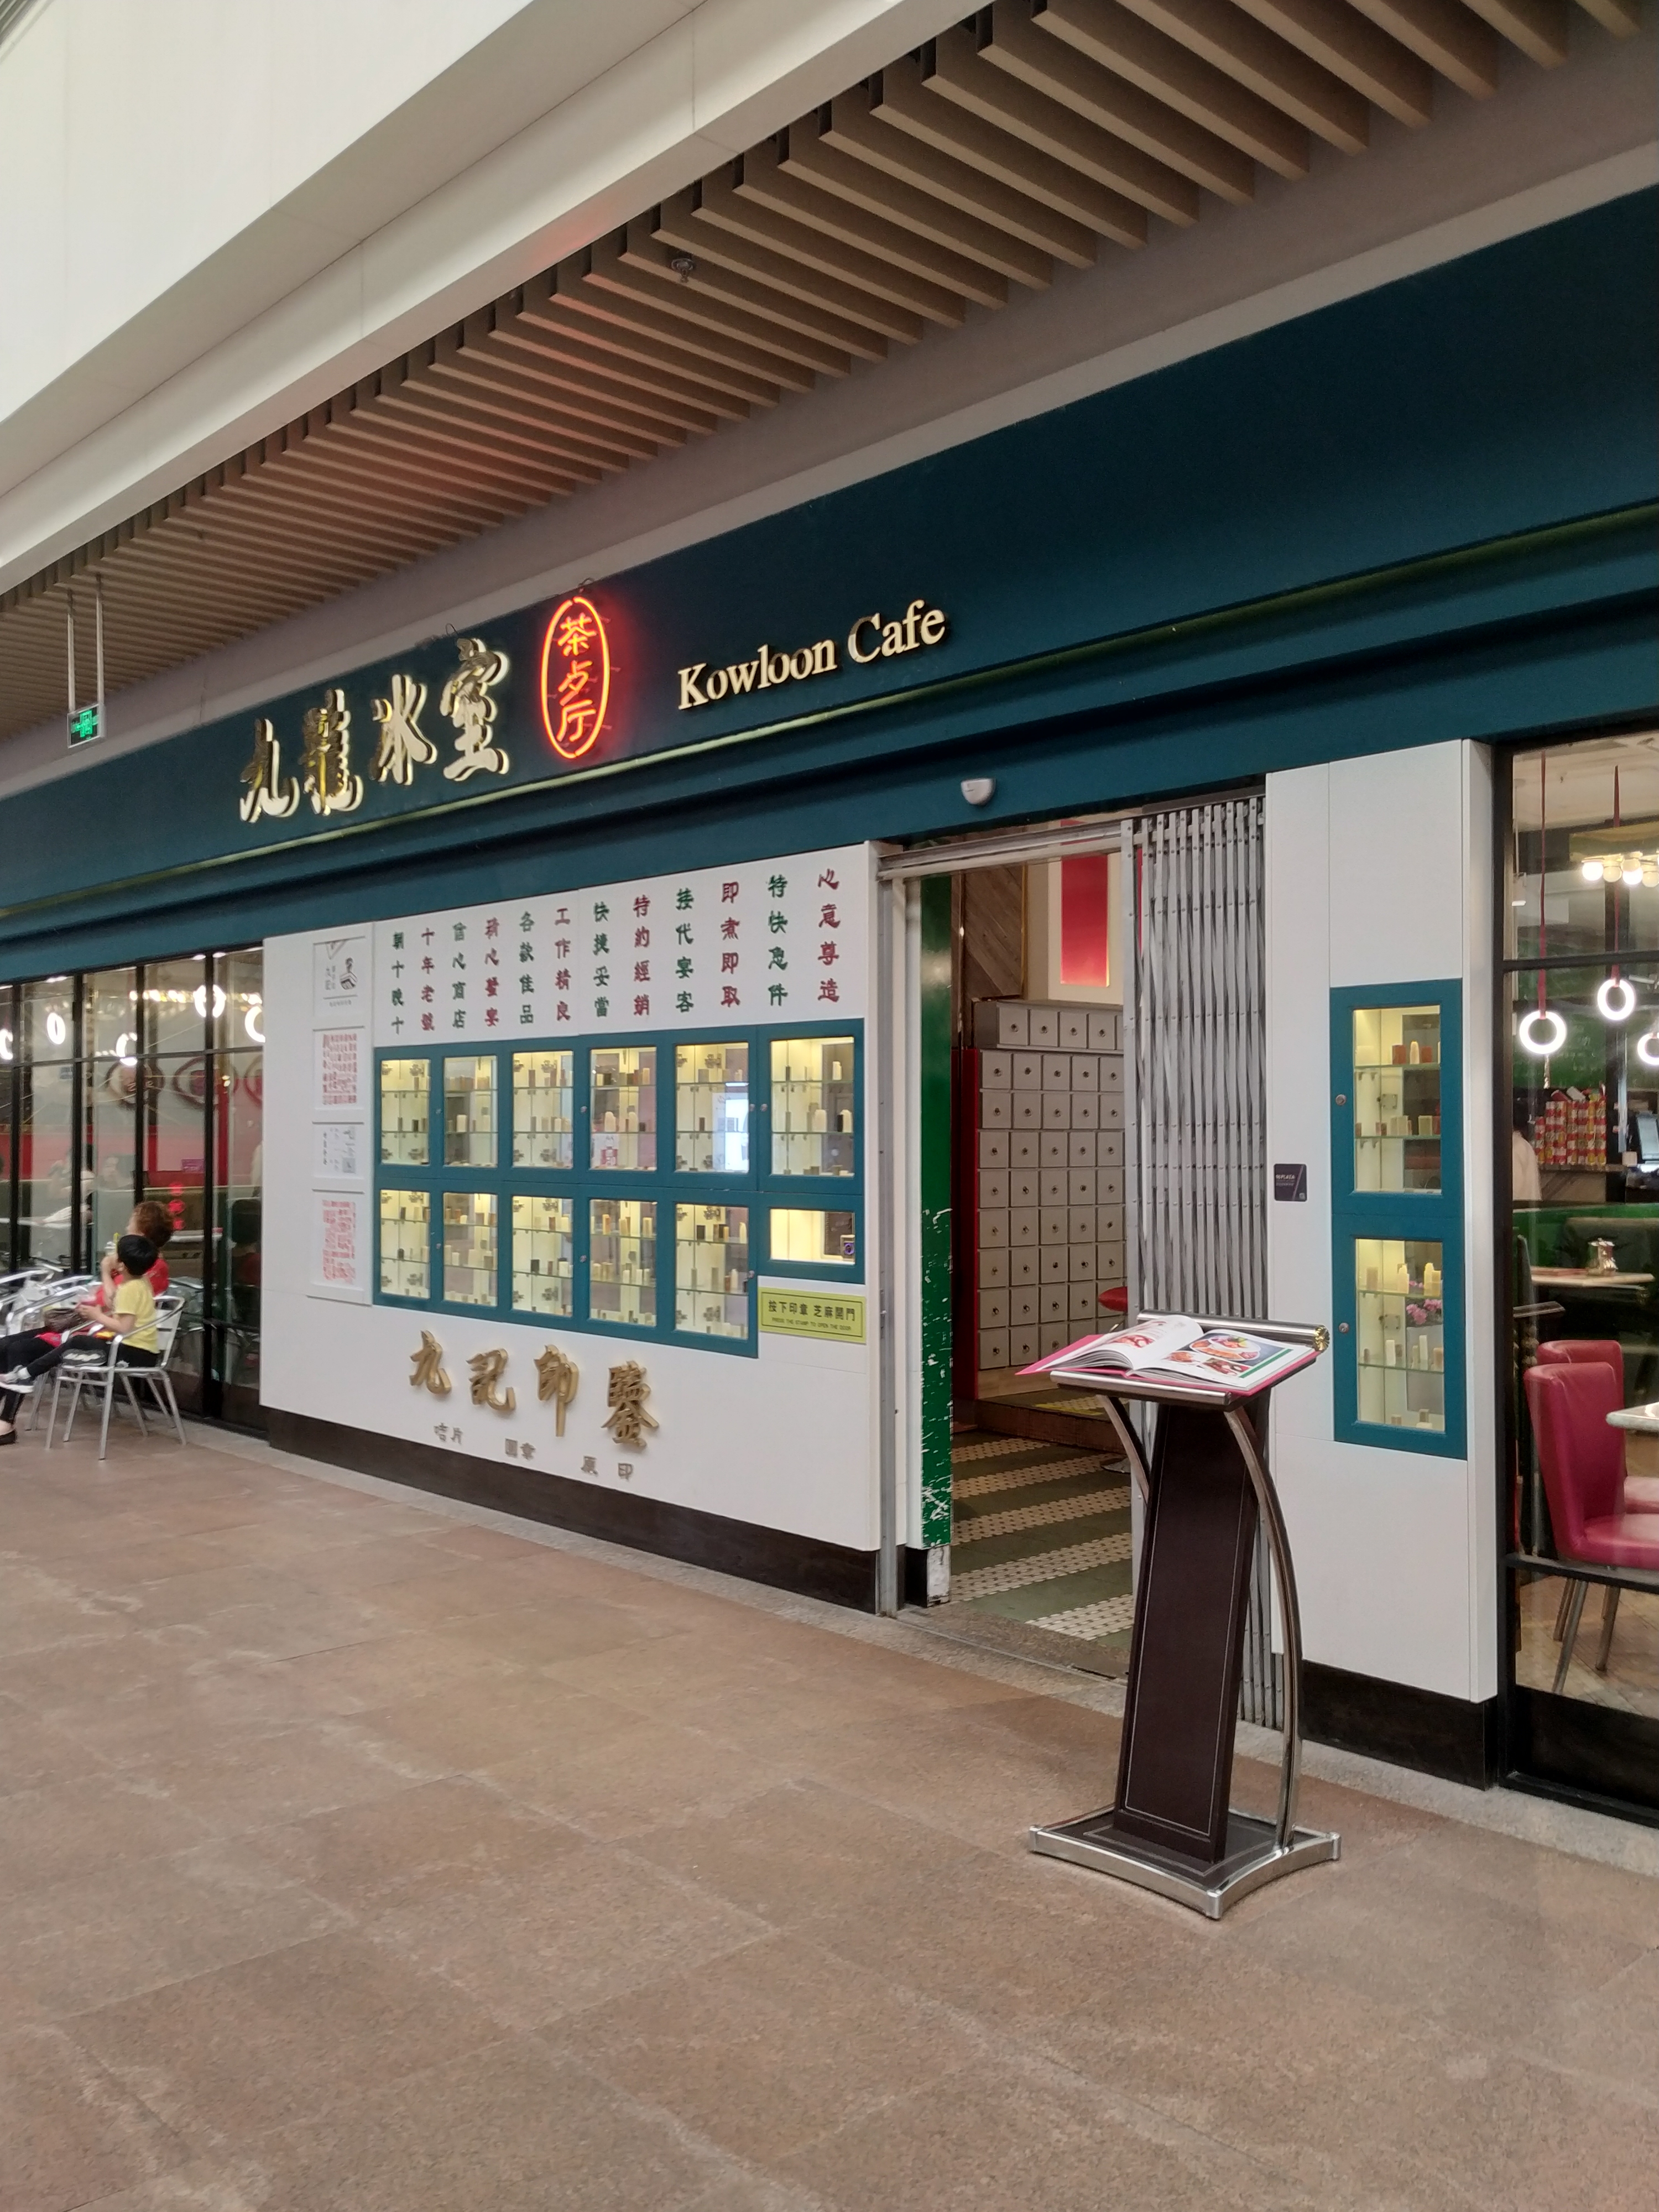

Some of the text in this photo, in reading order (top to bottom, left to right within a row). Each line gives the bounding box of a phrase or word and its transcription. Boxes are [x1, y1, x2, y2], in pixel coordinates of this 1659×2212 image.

[678, 599, 945, 710] Kowloon Cafe
[519, 911, 535, 1024] 各款佳品
[555, 908, 571, 1021] 工作精良
[633, 894, 651, 1016] 特約經銷
[721, 881, 740, 1008] 即煮即取
[768, 874, 788, 1006] 特快急件
[817, 868, 841, 1003] 心意尊造
[768, 1300, 855, 1322] 按下印章 芝麻開門
